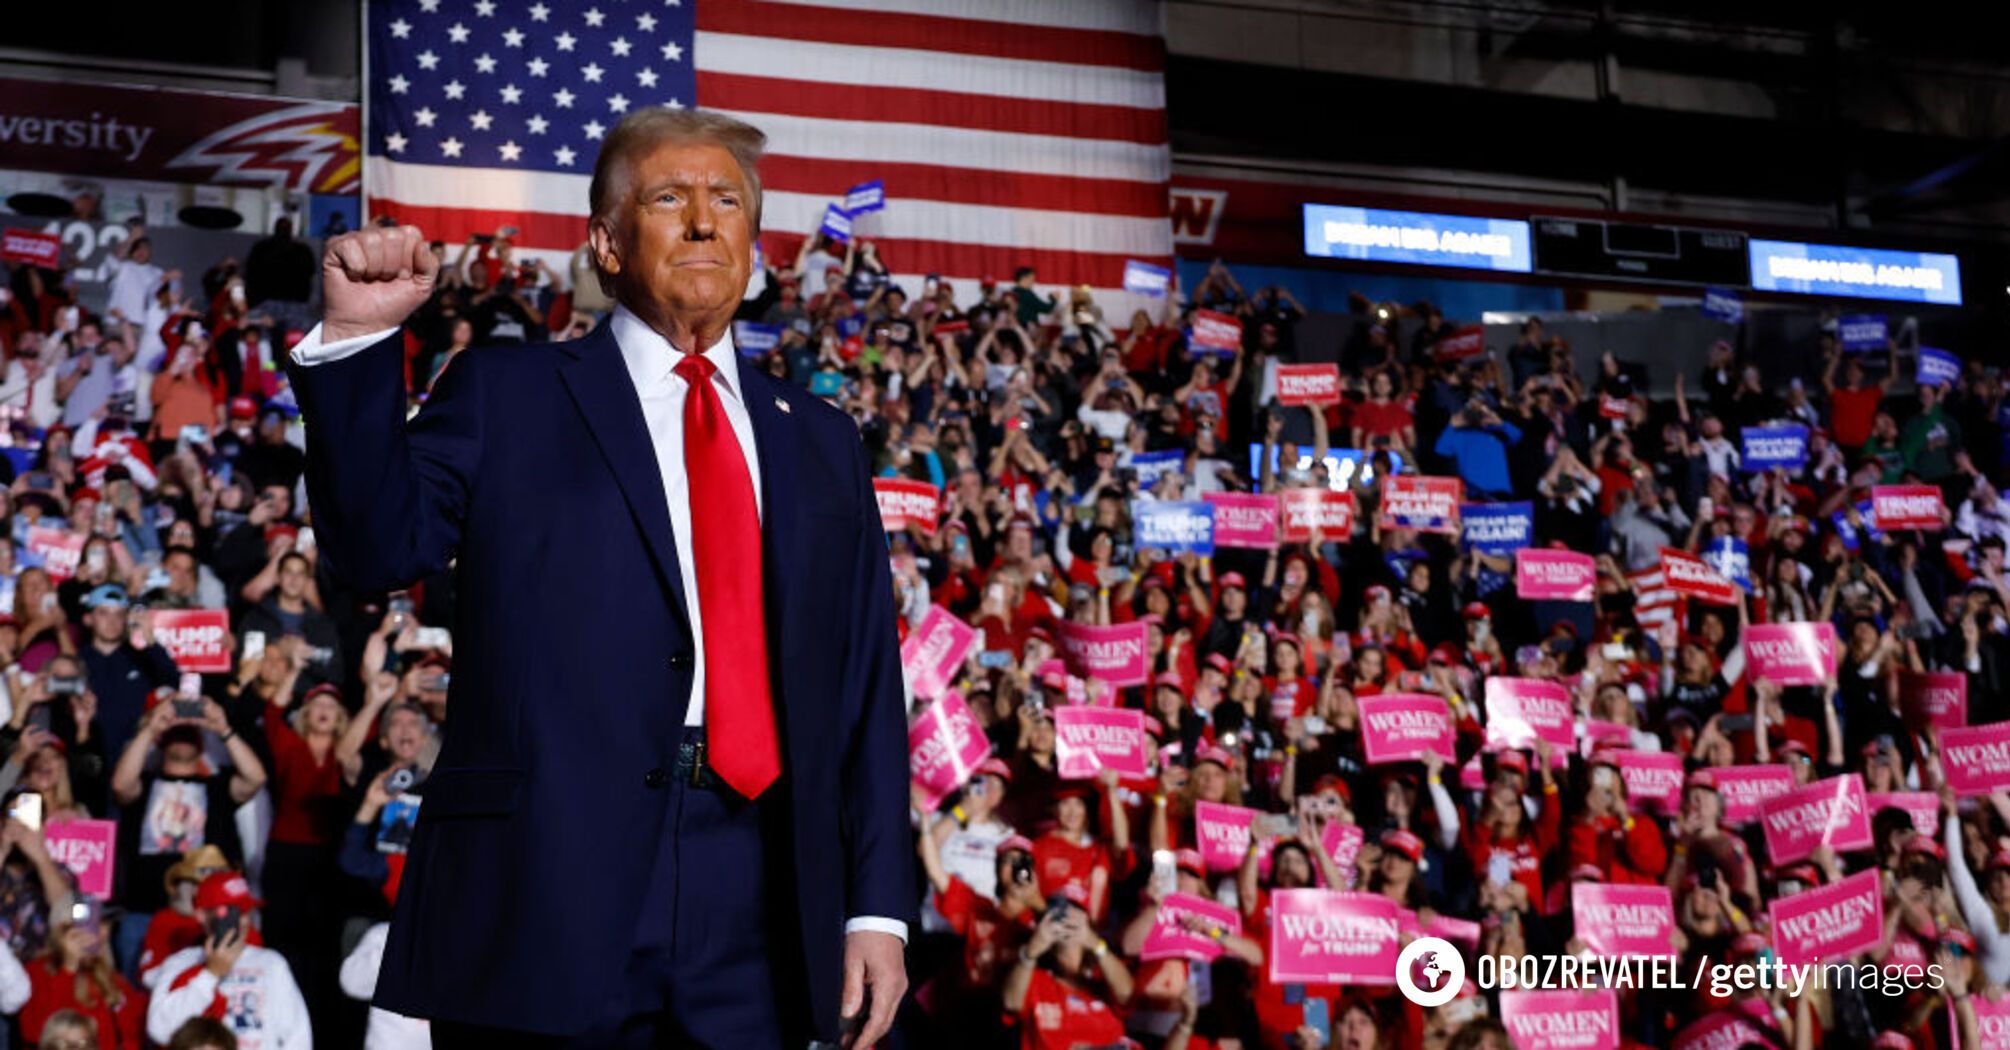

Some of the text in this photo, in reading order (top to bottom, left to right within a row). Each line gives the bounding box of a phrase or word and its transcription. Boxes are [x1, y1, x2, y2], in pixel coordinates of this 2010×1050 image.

[1215, 506, 1273, 522] OMEN
[1522, 562, 1592, 578] WOMEN
[153, 624, 224, 642] RUMP
[1367, 709, 1449, 734] WOMEN
[1063, 723, 1140, 746] WOMEN
[1622, 766, 1684, 788] OMEN
[1768, 795, 1861, 832] WOMEN
[1202, 822, 1251, 843] WOM
[46, 839, 106, 863] MEN
[1583, 904, 1669, 926] WOMEN
[1779, 892, 1876, 941] WOMEN
[1281, 912, 1400, 941] WOMEN
[1322, 940, 1383, 957] TRUMP
[1511, 1010, 1610, 1038] WOMEN
